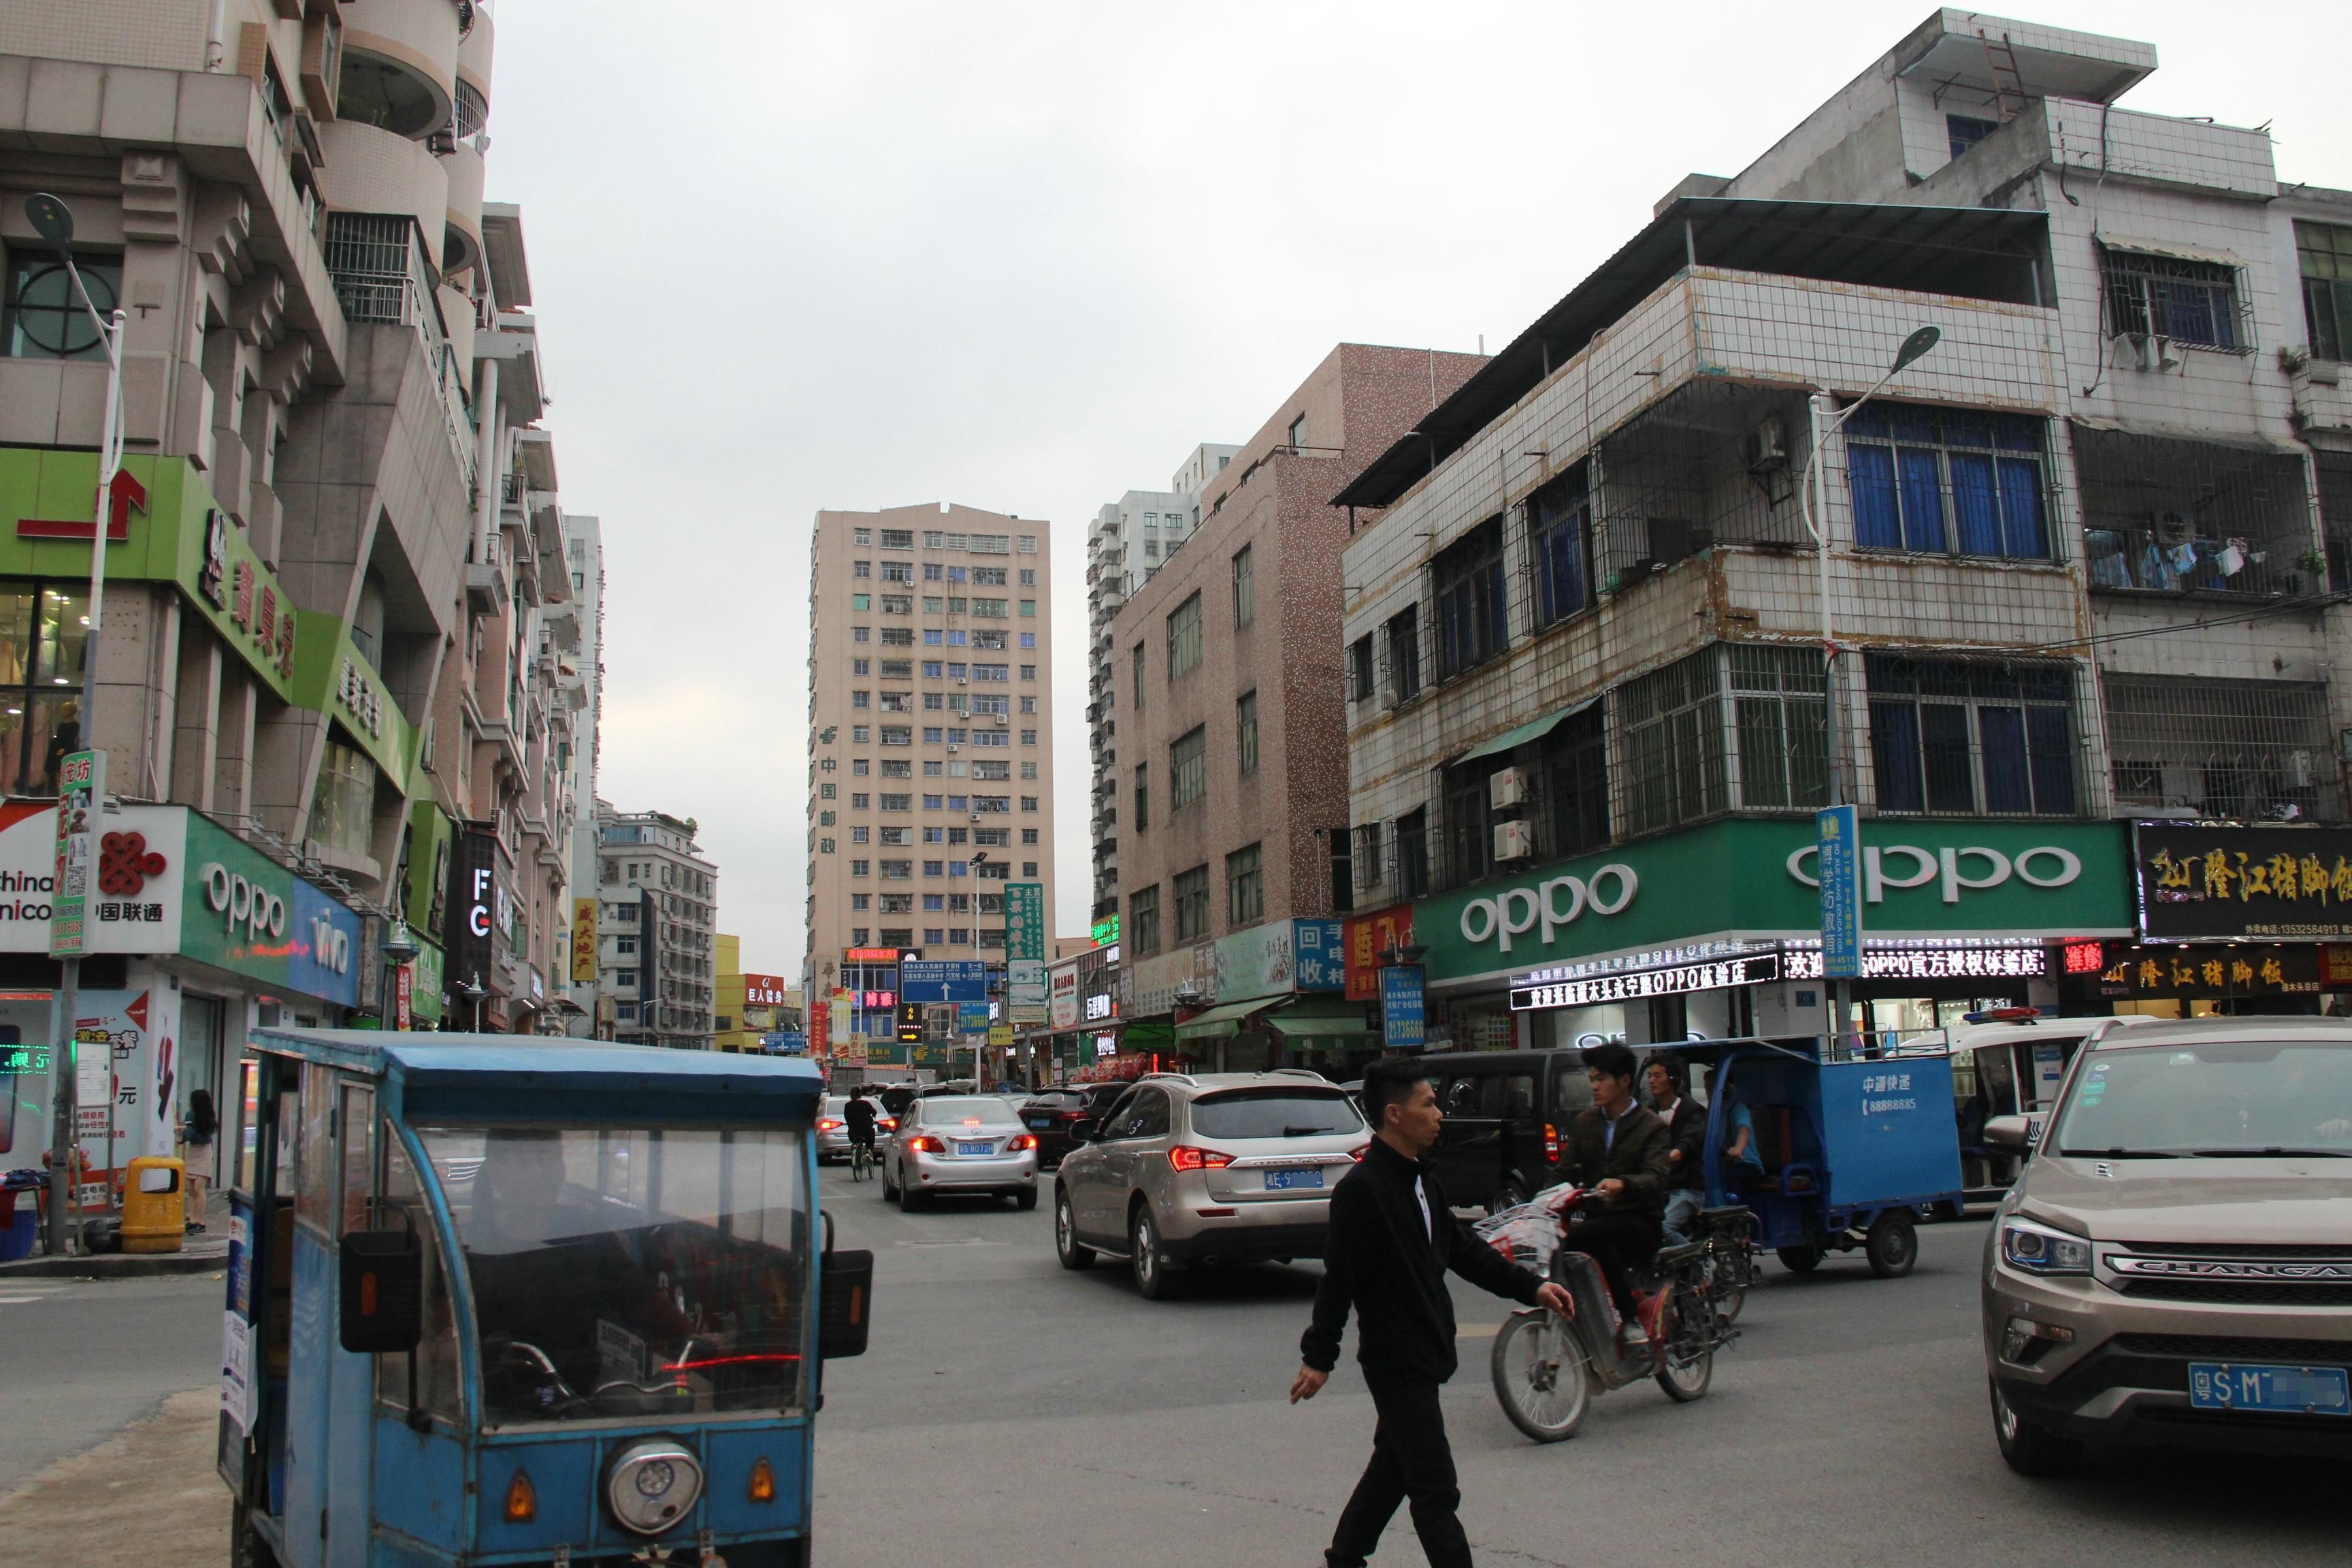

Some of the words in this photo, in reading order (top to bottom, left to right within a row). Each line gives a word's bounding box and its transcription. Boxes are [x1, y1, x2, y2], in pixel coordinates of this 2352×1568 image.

[61, 758, 91, 786] 宠坊
[821, 756, 836, 854] 中国邮政
[0, 870, 54, 892] hina
[96, 902, 163, 922] 国联通
[205, 862, 285, 942] oppo
[1460, 863, 1638, 952] oppo
[311, 908, 348, 974] vivo
[575, 905, 593, 973] 盛大地产
[1298, 926, 1323, 984] 回收
[1789, 952, 2041, 977] 欢迎OPPO官方授权体验店
[2066, 946, 2102, 970] 维修
[749, 988, 782, 1004] 巨人健身
[866, 992, 898, 1007] 博雅
[960, 1015, 988, 1029] 21736666
[1388, 1021, 1424, 1040] 21736666
[1863, 1074, 1910, 1093] 中通快递
[118, 1087, 137, 1105] 元
